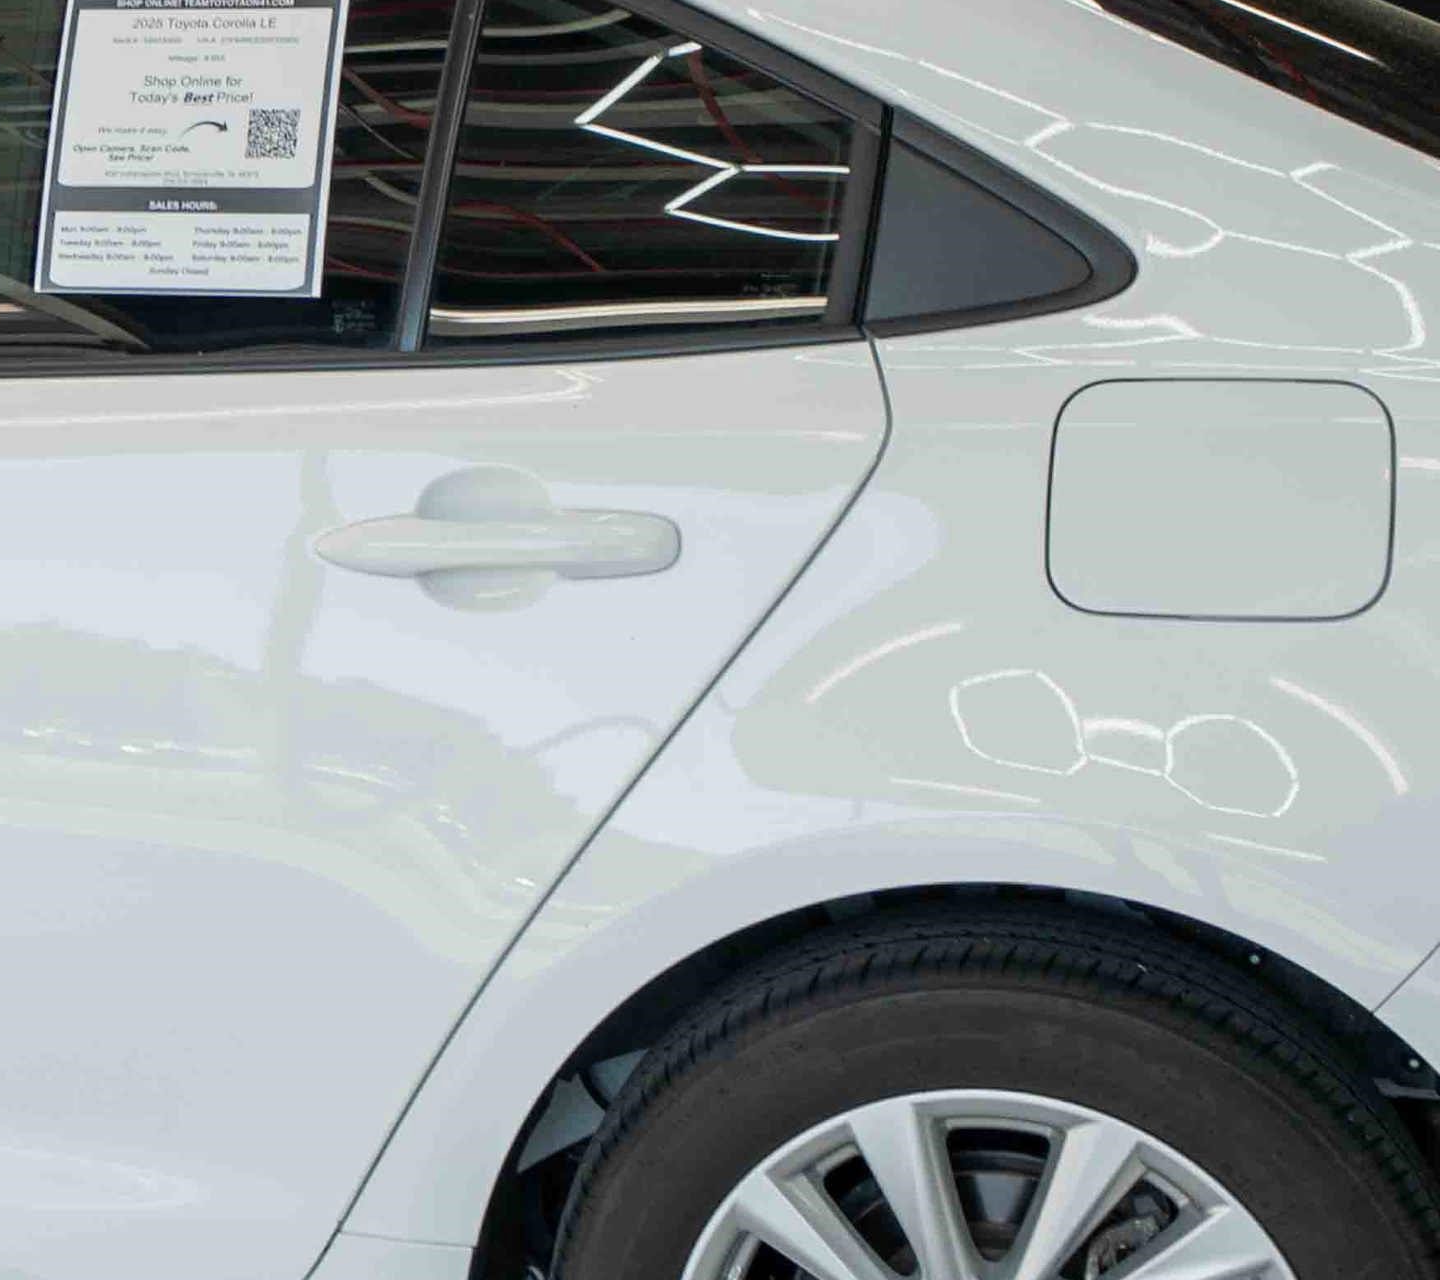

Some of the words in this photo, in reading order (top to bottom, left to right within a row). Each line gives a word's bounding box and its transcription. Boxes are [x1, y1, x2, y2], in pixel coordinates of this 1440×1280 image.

[166, 17, 210, 31] Toyota
[211, 17, 257, 30] Corolla
[259, 17, 278, 30] LE
[143, 75, 177, 88] Shop
[180, 75, 222, 87] Online
[225, 75, 244, 88] for
[128, 91, 179, 105] Today's
[183, 91, 215, 104] Best
[216, 91, 255, 104] Price!
[72, 144, 98, 154] Open
[148, 201, 180, 210] SALES
